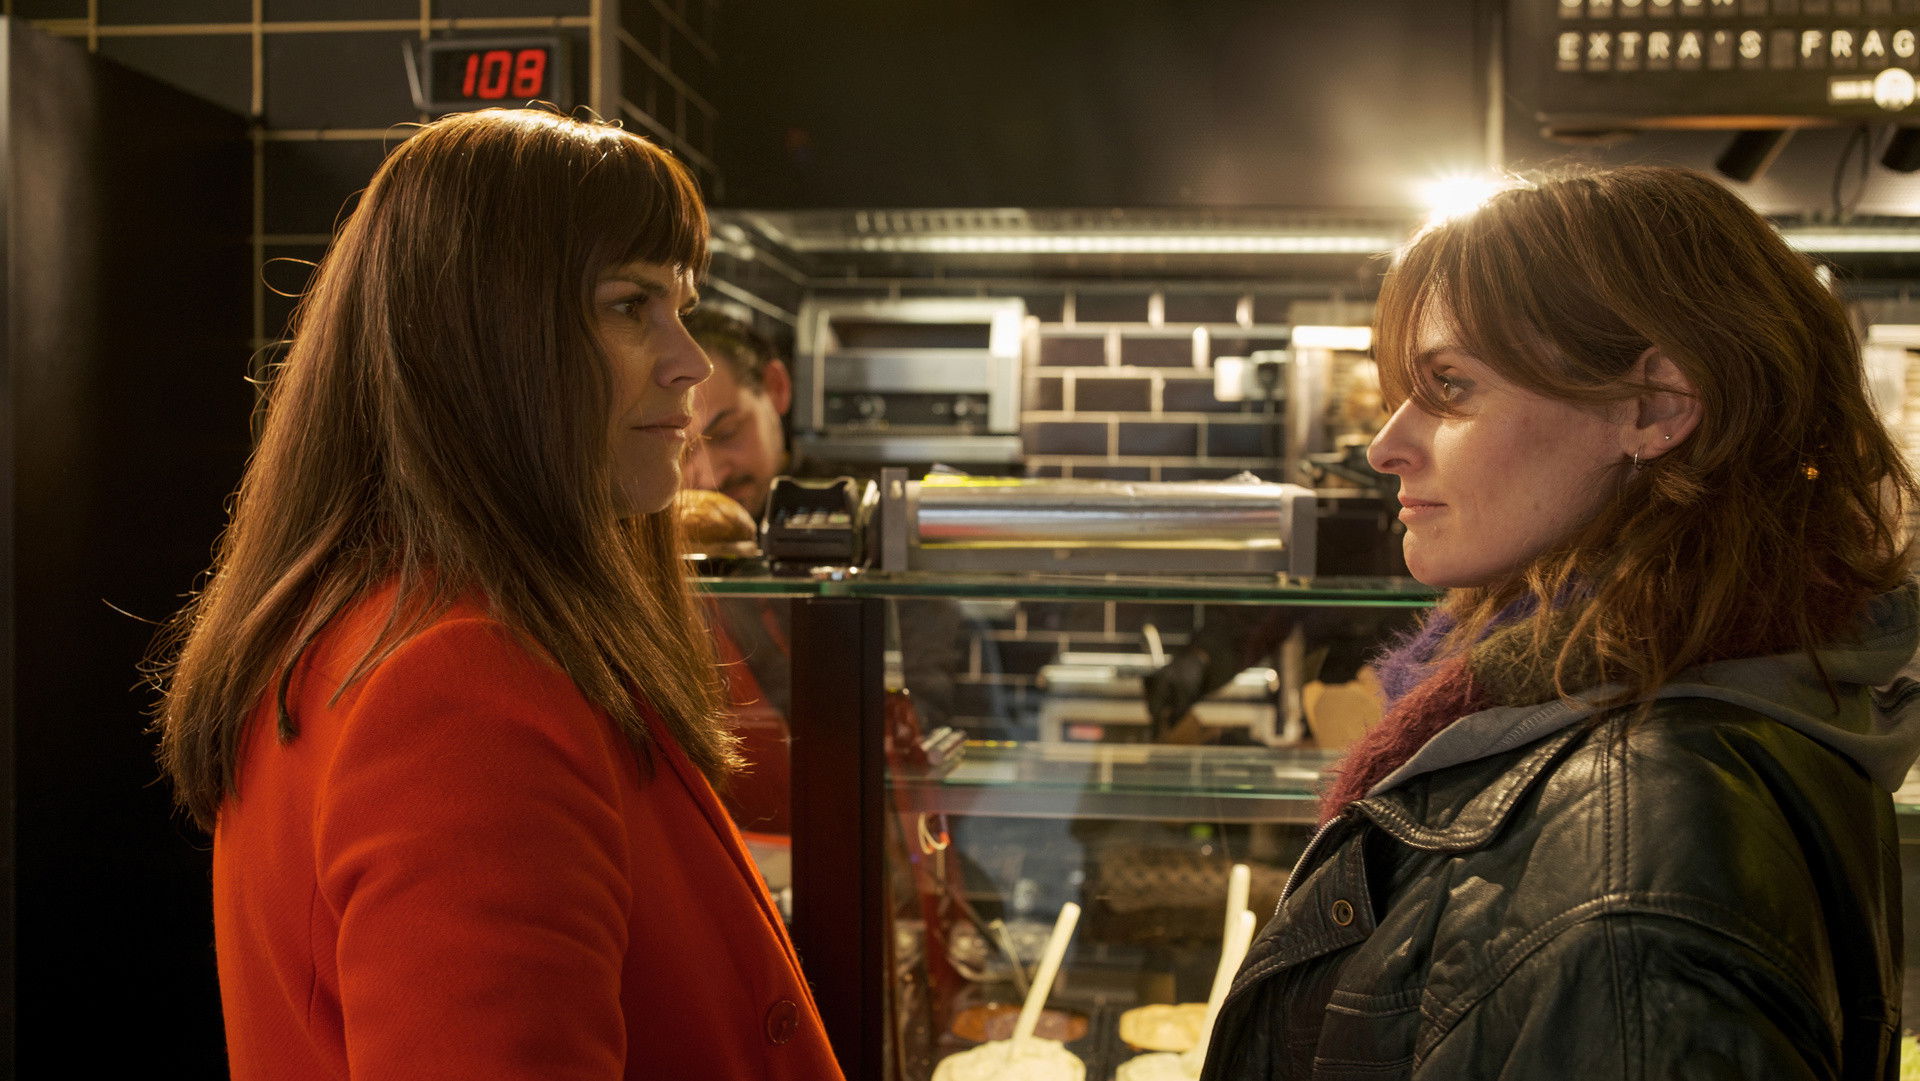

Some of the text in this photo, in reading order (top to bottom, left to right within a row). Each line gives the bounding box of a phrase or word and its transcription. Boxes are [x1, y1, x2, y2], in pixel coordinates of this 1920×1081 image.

[1558, 29, 1916, 60] EXTRA'S FRAG
[462, 49, 547, 99] 108
